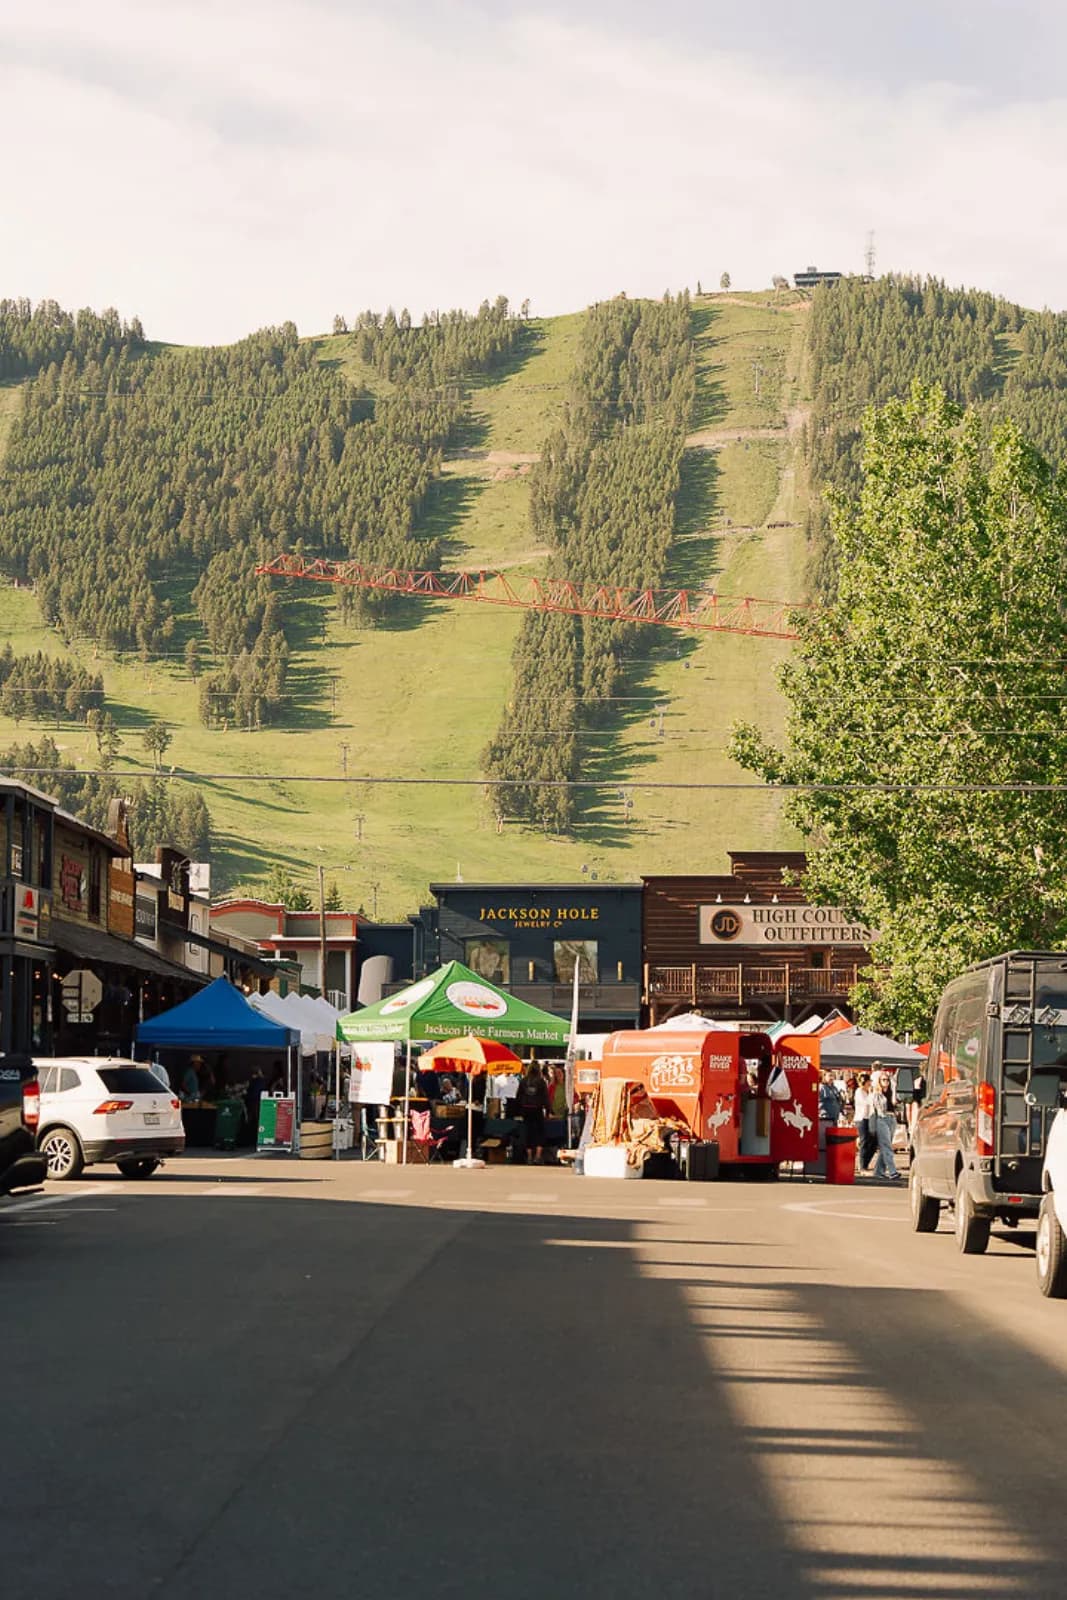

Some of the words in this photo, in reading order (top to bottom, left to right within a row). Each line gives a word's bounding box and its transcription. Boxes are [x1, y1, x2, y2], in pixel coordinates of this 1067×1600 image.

[480, 908, 551, 920] JACKSON
[558, 908, 599, 919] HOLE
[752, 909, 796, 923] HIGH
[514, 920, 550, 928] JEWELRY
[764, 926, 872, 941] OUTFITTERS
[424, 1024, 460, 1035] Jackson
[463, 1025, 485, 1037] Hole
[488, 1026, 524, 1039] Farmers
[527, 1028, 558, 1041] Market
